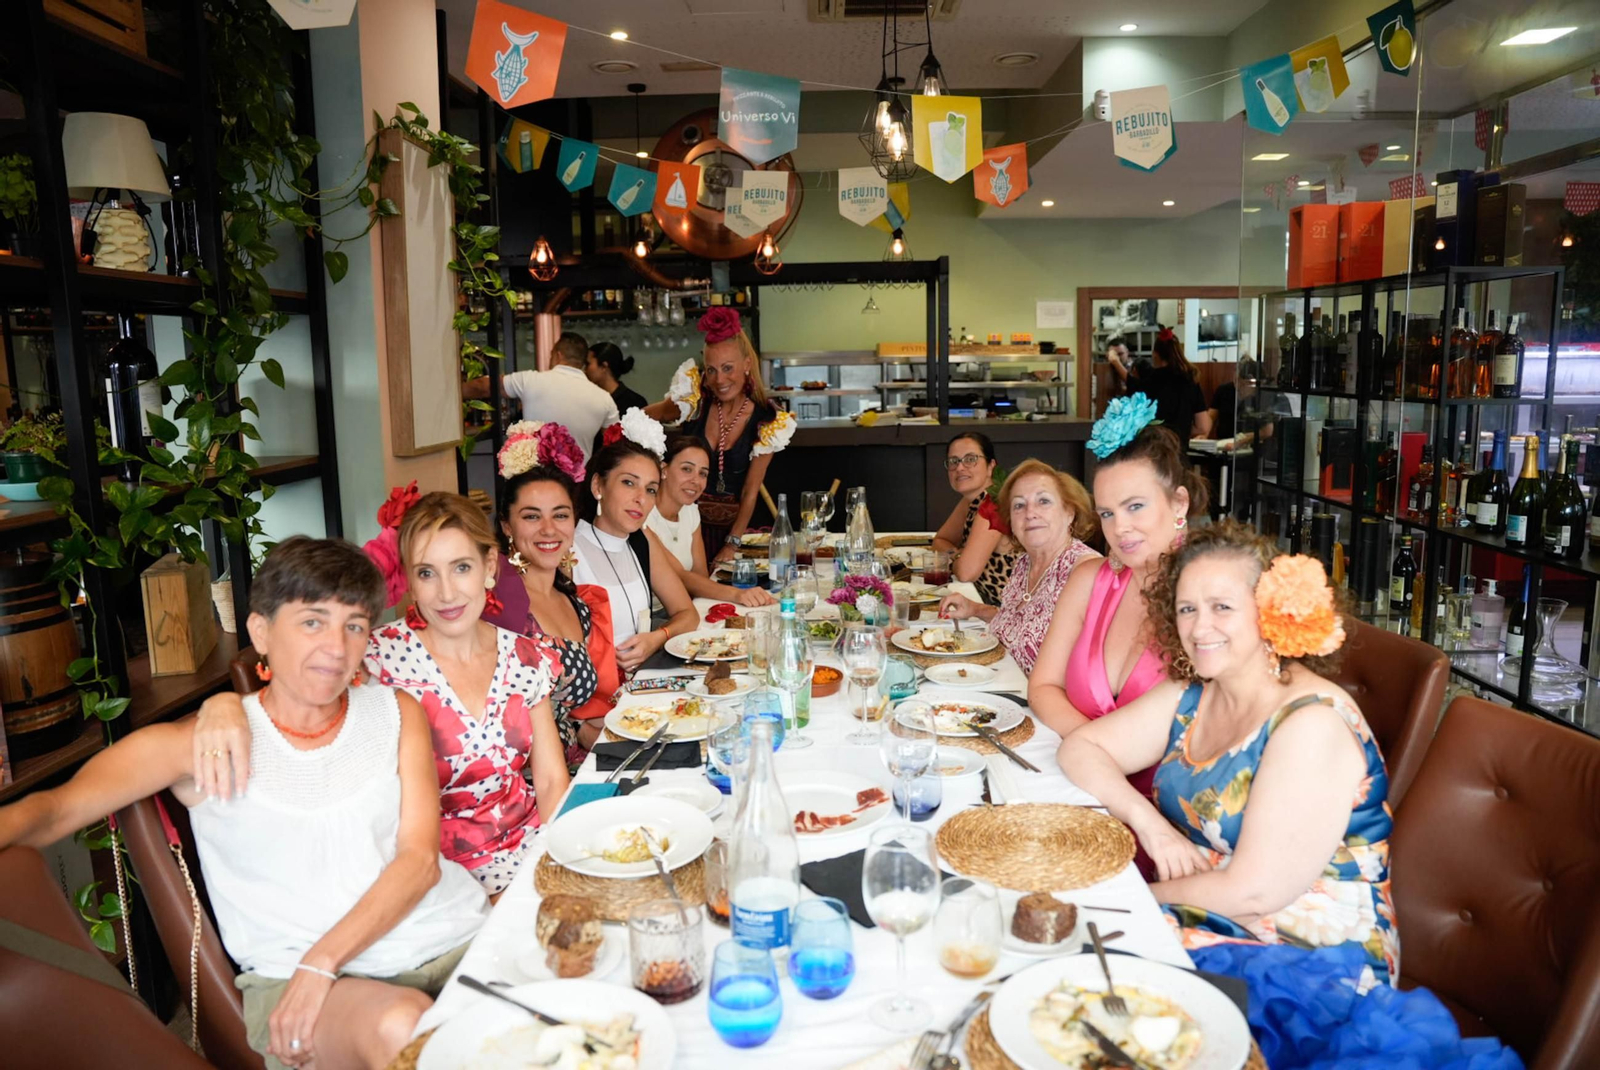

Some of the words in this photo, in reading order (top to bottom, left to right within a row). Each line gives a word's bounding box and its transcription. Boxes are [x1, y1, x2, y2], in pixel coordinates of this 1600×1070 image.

[721, 110, 779, 123] Universo
[781, 112, 796, 124] Vi
[1115, 112, 1168, 135] REBUJITO
[744, 187, 785, 202] REBUJITO
[841, 186, 885, 201] REBUJITO
[1312, 225, 1328, 238] 21
